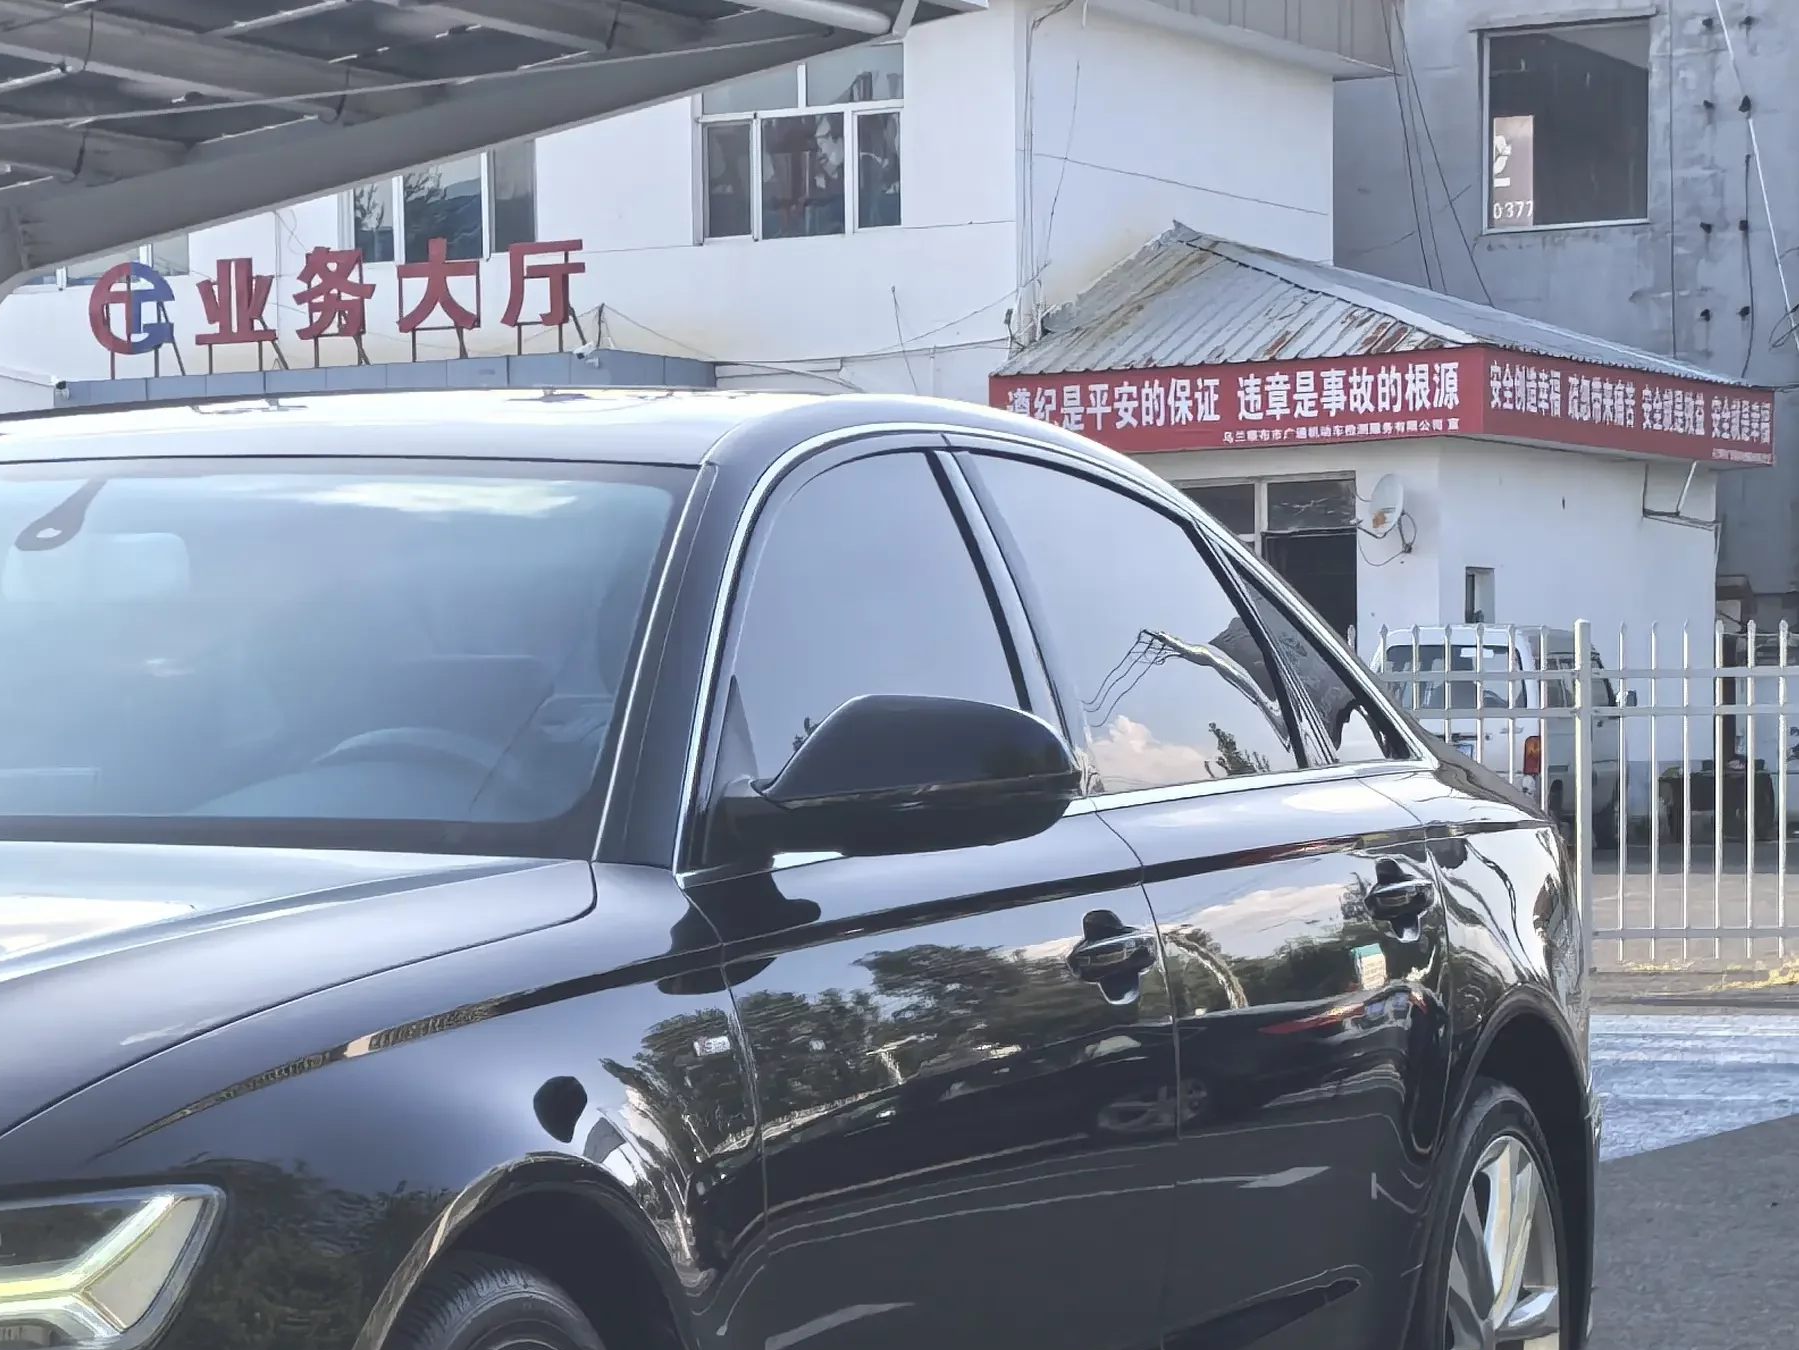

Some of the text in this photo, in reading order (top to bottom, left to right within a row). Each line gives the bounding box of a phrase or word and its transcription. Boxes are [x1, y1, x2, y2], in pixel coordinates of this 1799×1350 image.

[196, 237, 586, 344] 业务大厅
[1237, 361, 1460, 421] 违章是事故的根源
[1490, 359, 1561, 418] 安全创造幸福
[1711, 395, 1771, 444] 安全就是幸福
